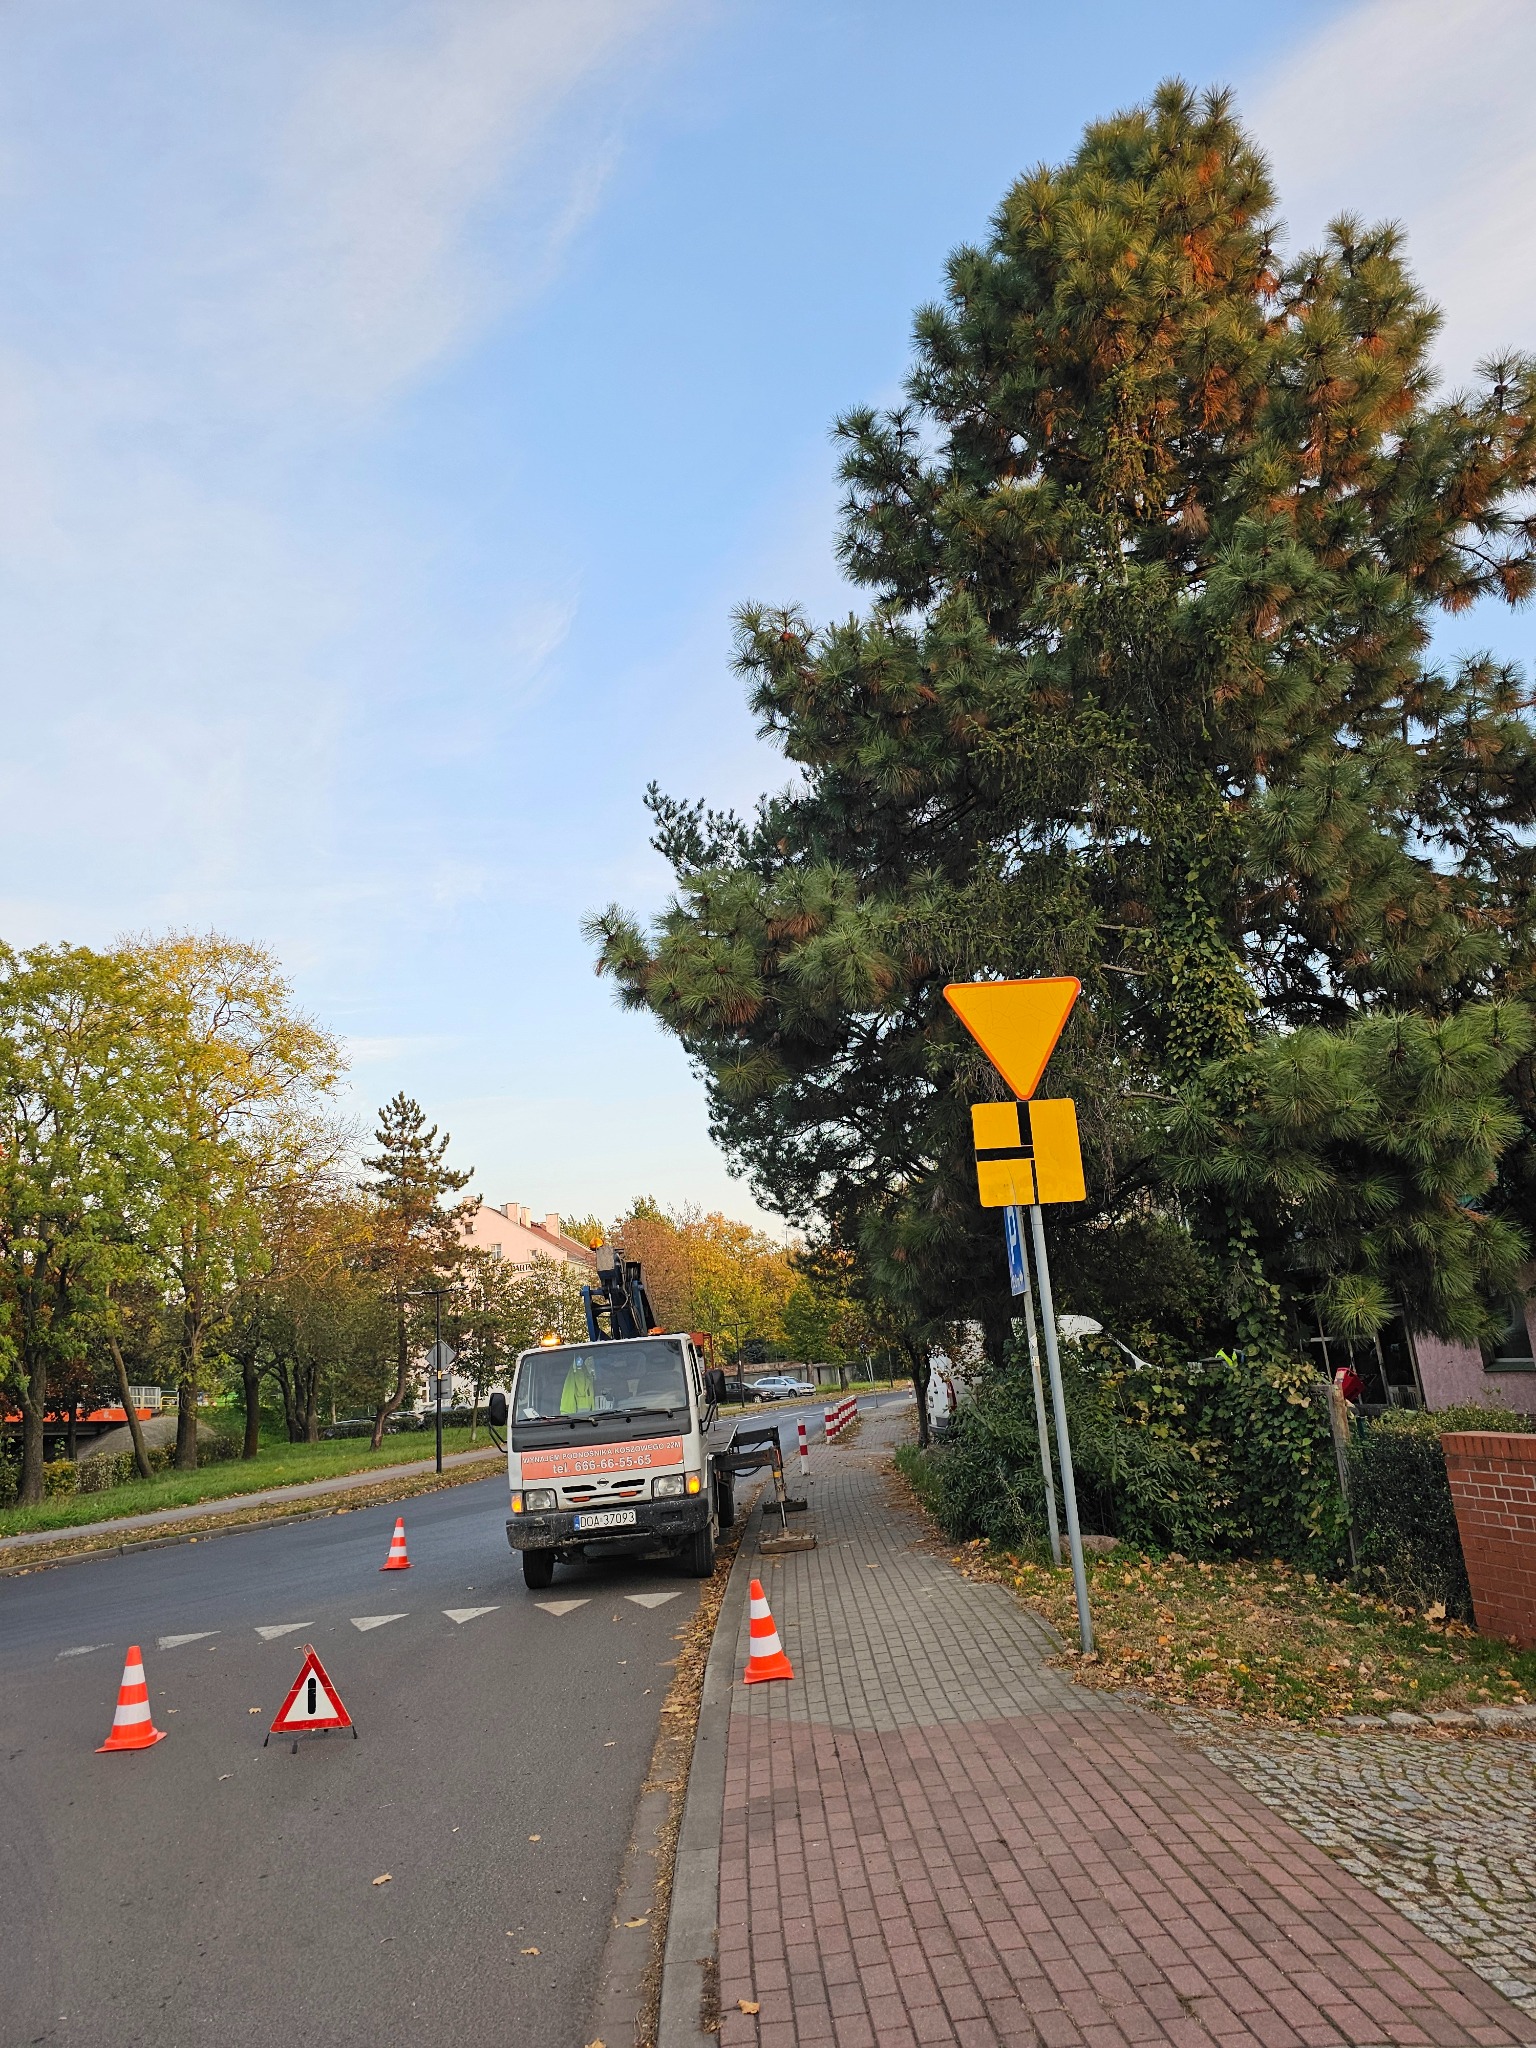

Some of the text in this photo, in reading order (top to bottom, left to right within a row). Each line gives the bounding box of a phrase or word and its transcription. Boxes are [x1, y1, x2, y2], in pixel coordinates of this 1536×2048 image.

[1006, 1207, 1018, 1264] P
[522, 1454, 560, 1464] WYNAJEM
[614, 1443, 665, 1454] KOSZOWEGO
[666, 1441, 681, 1449] 22M
[553, 1454, 651, 1473] tel. 666-66-55-65
[580, 1511, 635, 1528] DOA 37093
